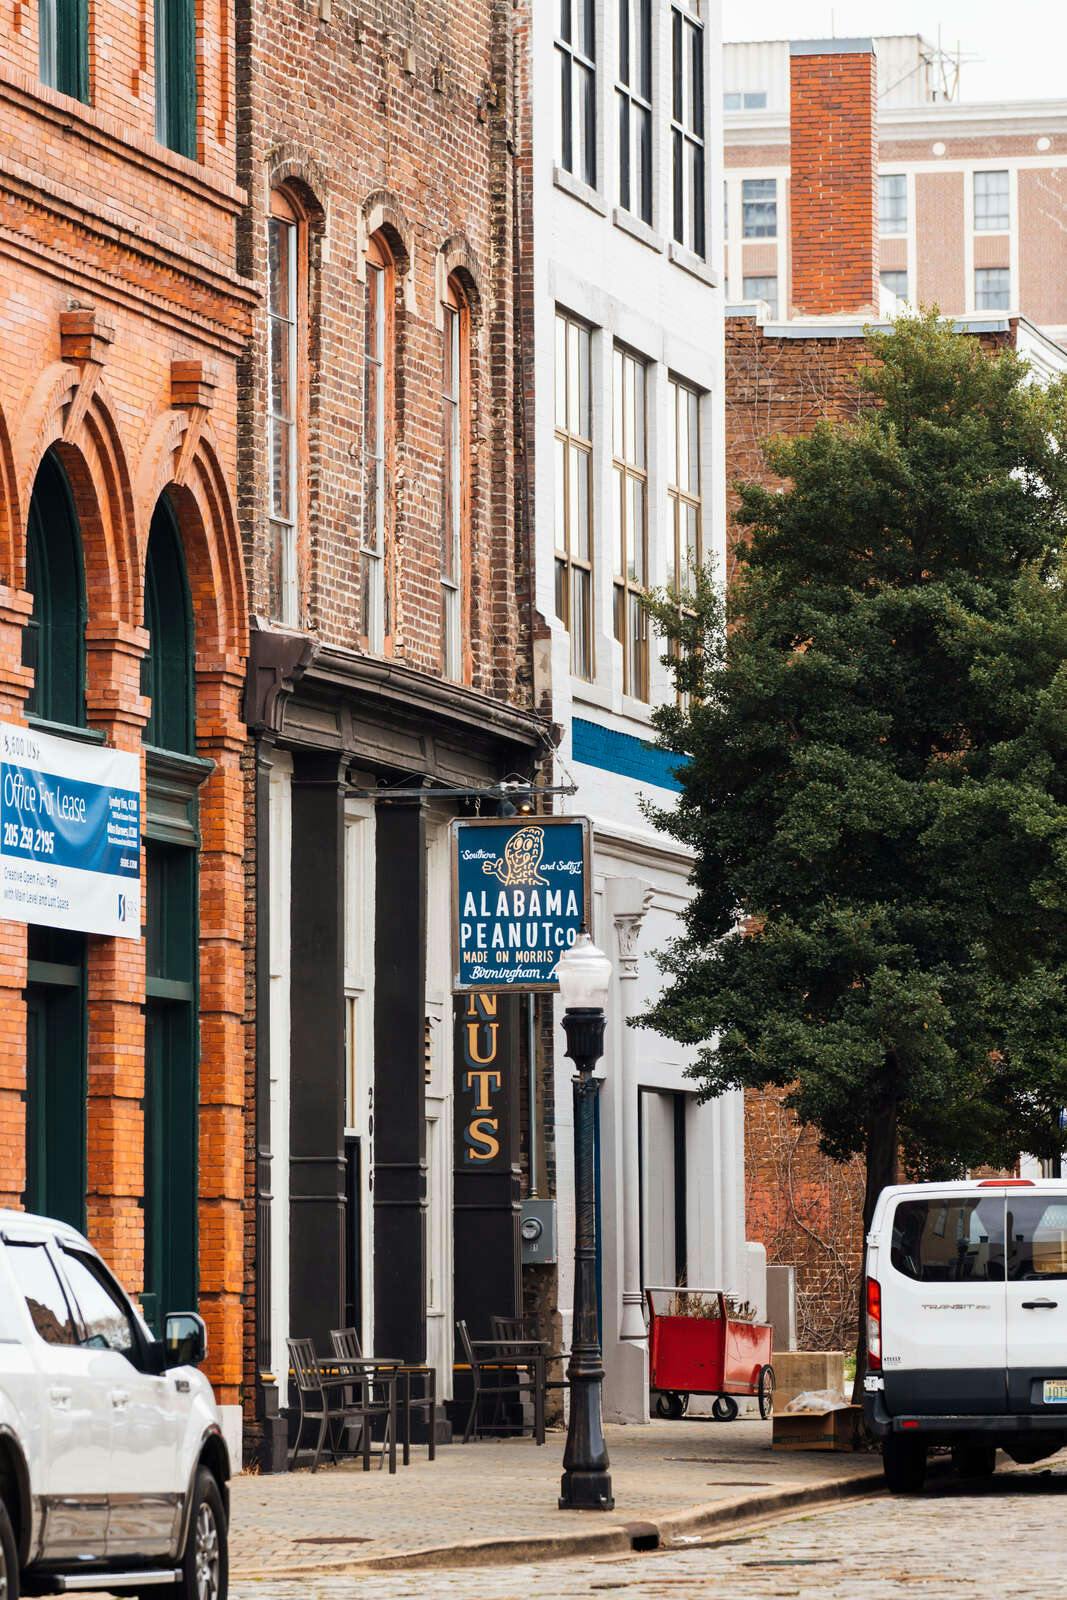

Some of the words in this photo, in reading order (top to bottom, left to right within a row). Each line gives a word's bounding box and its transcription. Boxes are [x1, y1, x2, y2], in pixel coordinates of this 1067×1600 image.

[4, 773, 36, 812] Office
[39, 782, 55, 817] For
[57, 785, 87, 823] Lease
[4, 822, 18, 847] 205
[34, 829, 55, 855] 2195
[540, 861, 555, 870] and
[463, 889, 579, 917] ALABAMA
[460, 922, 554, 949] PEANUT
[463, 950, 488, 964] MADE
[495, 950, 509, 963] ON
[515, 949, 554, 964] MORRIS
